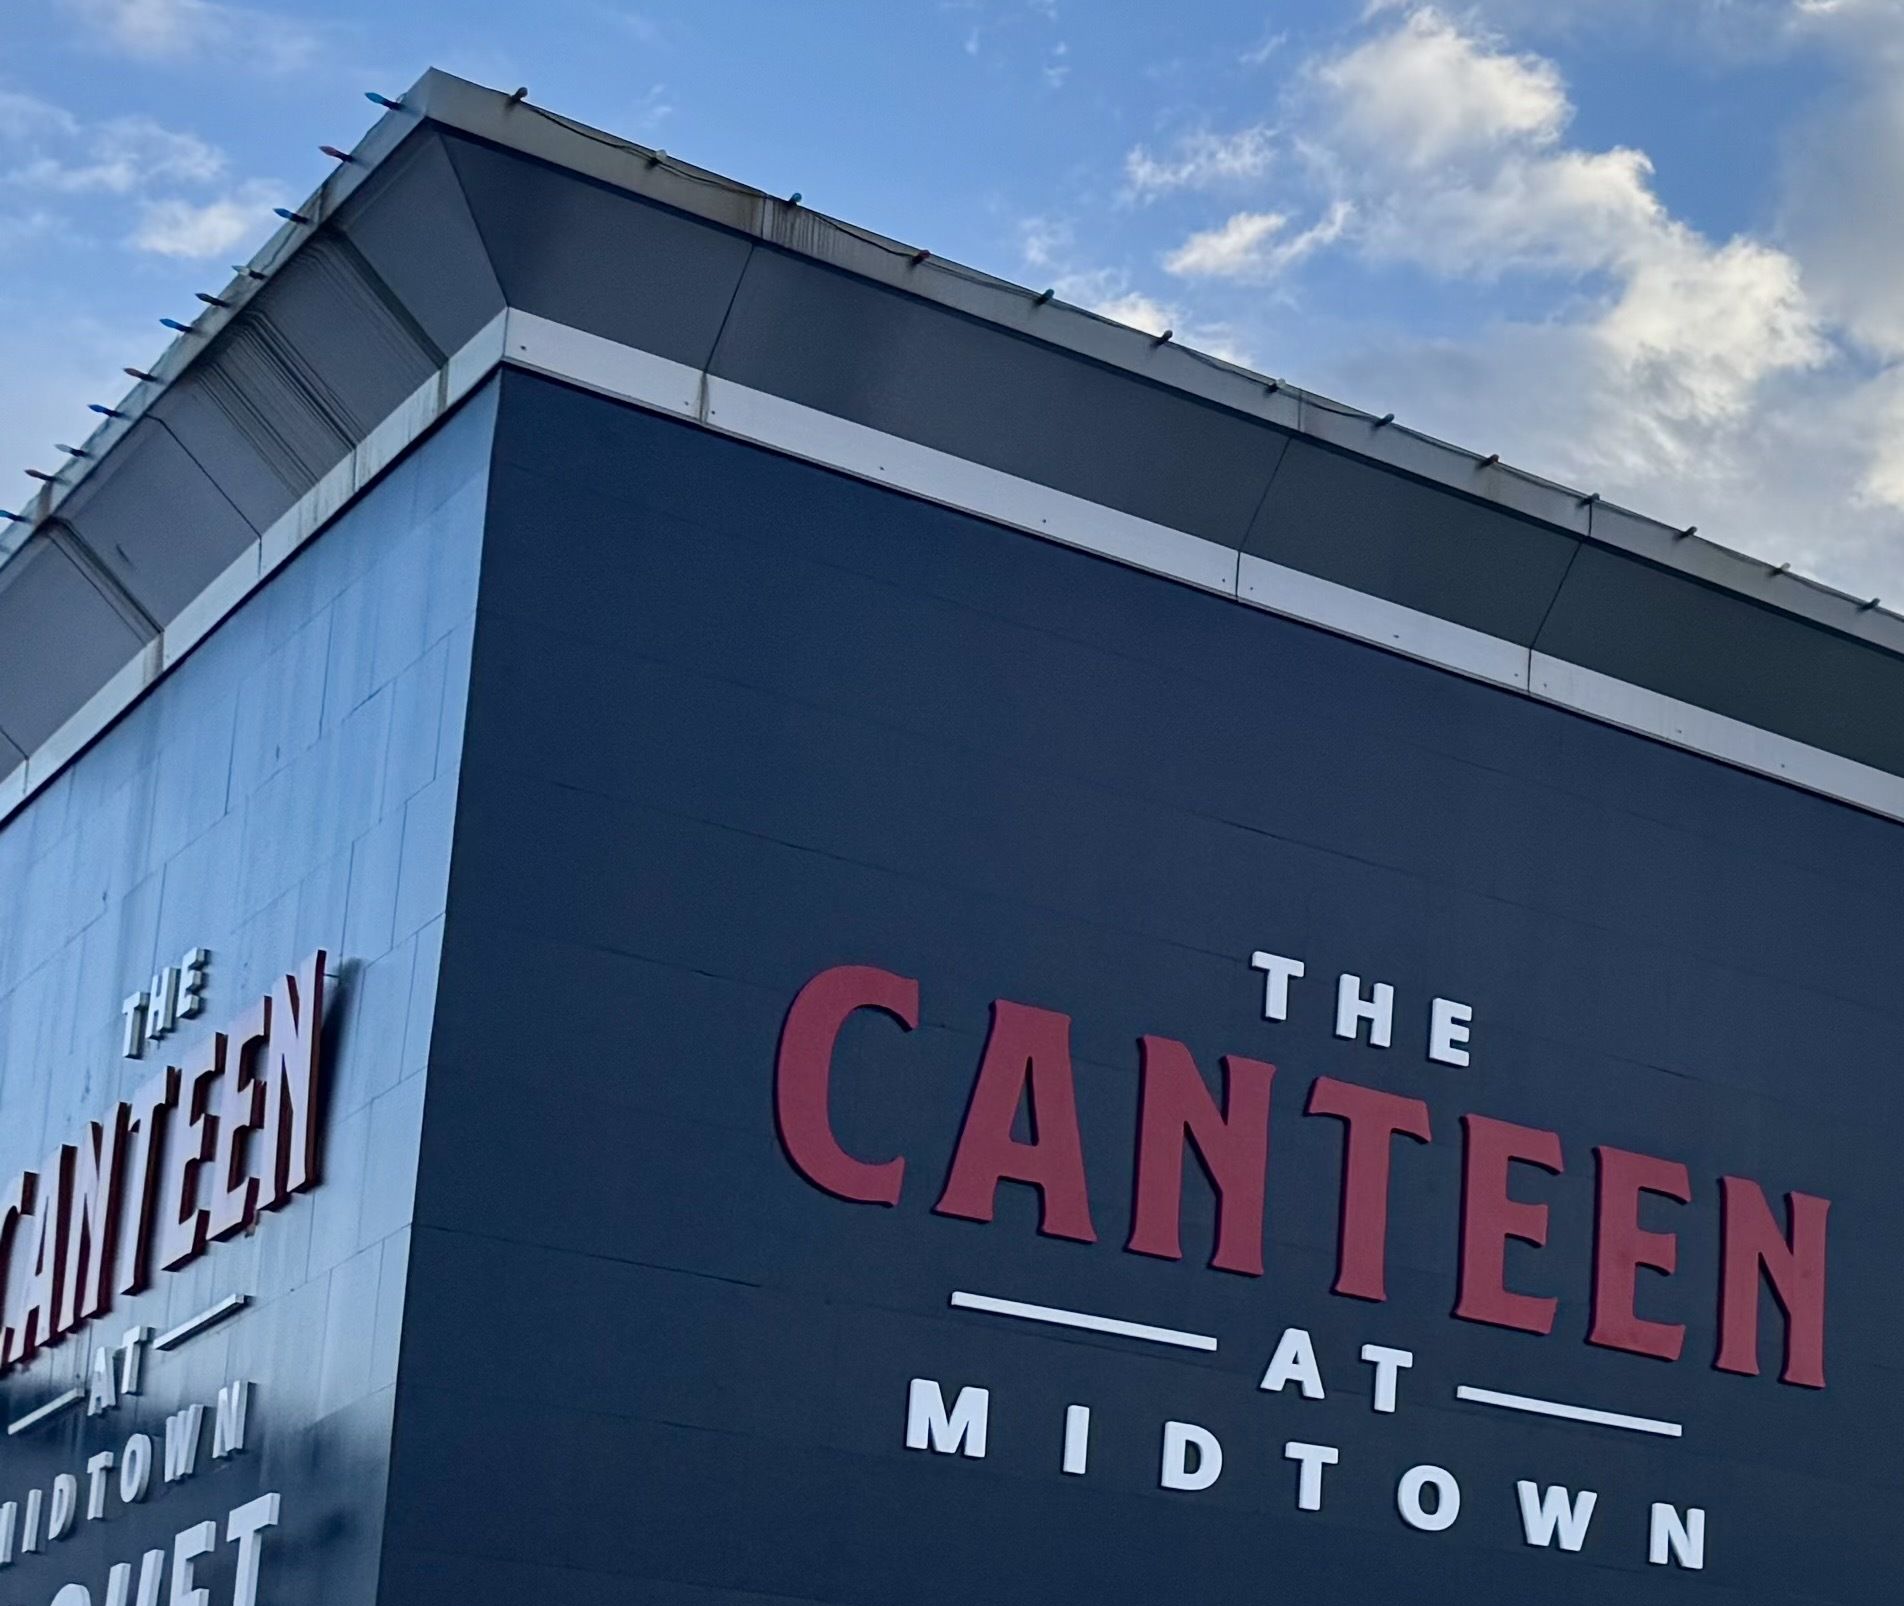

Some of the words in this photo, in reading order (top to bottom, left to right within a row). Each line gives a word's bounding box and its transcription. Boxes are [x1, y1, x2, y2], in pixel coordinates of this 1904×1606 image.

[122, 947, 211, 1060] THE
[1251, 950, 1473, 1067] THE
[774, 964, 1831, 1388] CANTEEN
[86, 1326, 152, 1417] AT
[1260, 1327, 1413, 1413] AT
[0, 1381, 256, 1563] IDTOWN
[906, 1378, 1706, 1569] MIDTOWN
